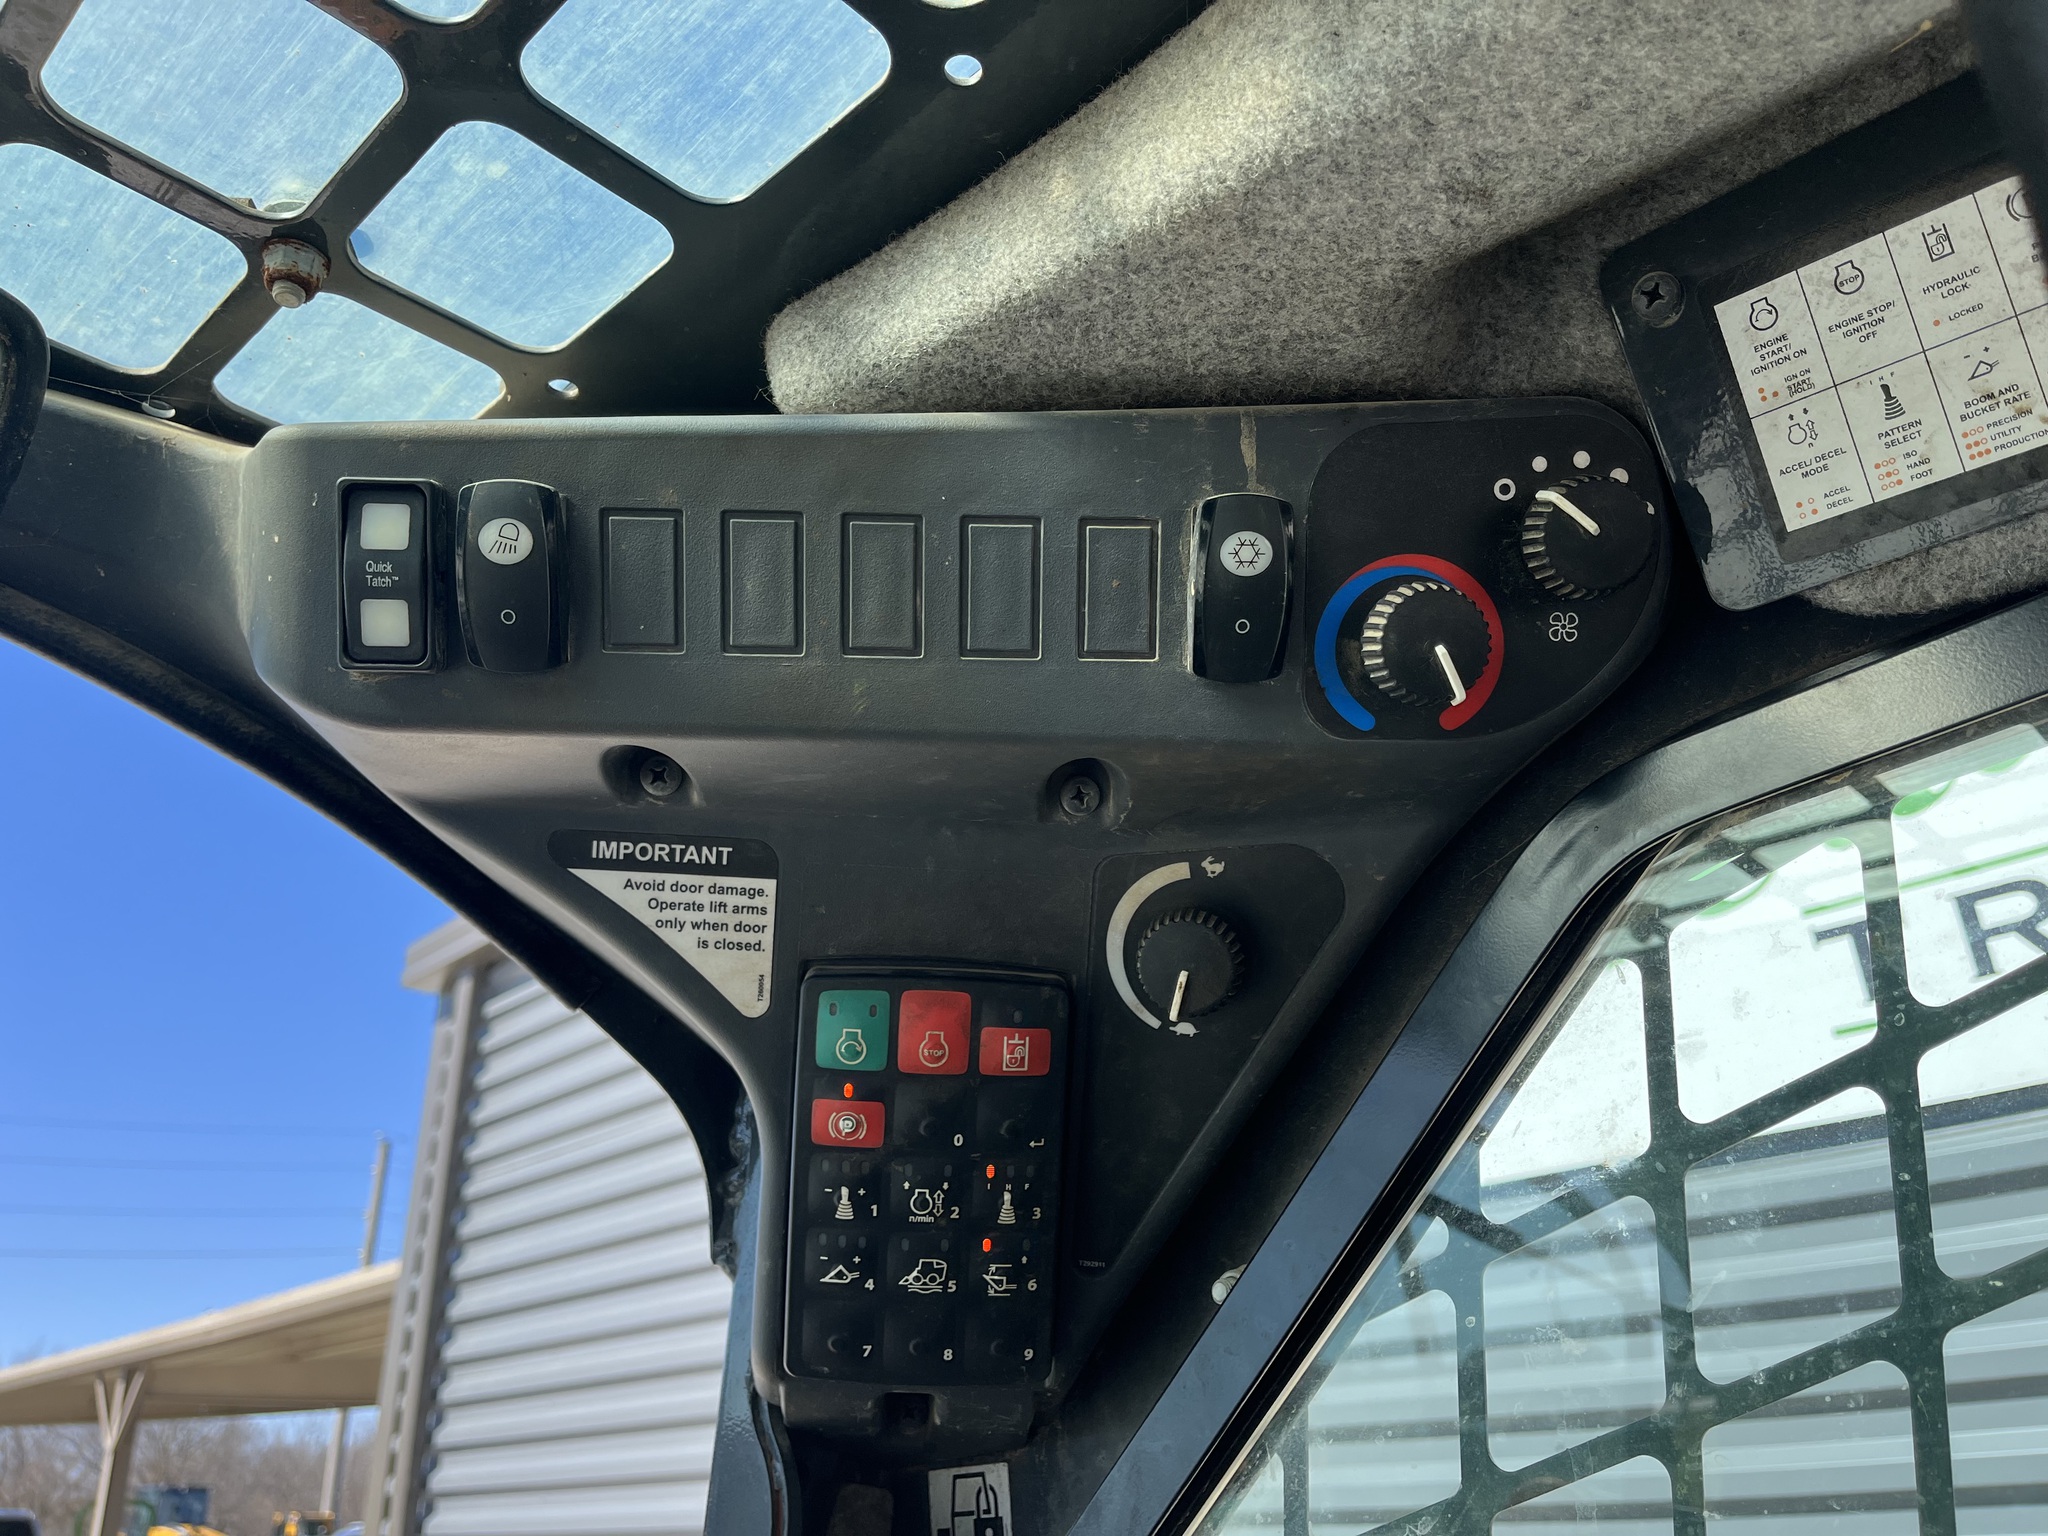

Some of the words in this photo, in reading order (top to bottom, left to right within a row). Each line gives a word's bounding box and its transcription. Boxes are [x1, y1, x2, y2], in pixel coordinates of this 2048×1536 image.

[1839, 274, 1860, 288] STOP
[1922, 265, 1981, 295] HYDRAULIC
[1941, 282, 1970, 299] LOCK
[1828, 313, 1865, 333] ENGINE
[1866, 300, 1896, 318] STOP/
[1948, 302, 1984, 321] LOCKED
[1842, 316, 1885, 339] IGNITION
[1753, 333, 1789, 353] ENGINE
[1858, 330, 1878, 343] OFF
[1759, 343, 1792, 362] START/
[1750, 354, 1791, 376] IGNITION
[1793, 347, 1807, 359] ON
[1783, 373, 1798, 383] IGN
[1799, 367, 1811, 377] ON
[1786, 376, 1811, 391] START
[1788, 382, 1816, 398] (HOLD)
[1963, 392, 1996, 409] BOOM
[1998, 383, 2020, 397] AND
[1959, 401, 2001, 423] BUCKET
[2004, 391, 2032, 407] RATE
[1986, 408, 2033, 430] PRECISION
[1877, 418, 1923, 440] PATTERN
[1990, 425, 2022, 441] UTILITY
[1884, 430, 1922, 449] SELECT
[1779, 458, 1813, 477] ACCEL/
[1814, 447, 1847, 464] DECEL
[1902, 449, 1918, 460] ISO
[1801, 463, 1830, 479] MODE
[1906, 457, 1931, 470] HAND
[1910, 468, 1933, 481] FOOT
[1823, 485, 1851, 499] ACCEL
[1826, 496, 1854, 510] DECEL
[365, 560, 393, 573] Quick
[592, 840, 733, 865] IMPORTANT
[623, 878, 665, 892] Avoid
[670, 881, 704, 894] door
[708, 883, 769, 899] damage.
[648, 898, 705, 912] Operate
[710, 901, 728, 914] lift
[732, 904, 768, 916] arms
[655, 917, 686, 932] only
[691, 919, 729, 932] when
[734, 921, 768, 934] door
[697, 937, 709, 949] is
[714, 938, 766, 952] closed.
[923, 1048, 945, 1057] STOP
[953, 1133, 964, 1147] 0
[1005, 1183, 1011, 1191] H
[870, 1204, 878, 1217] 1
[950, 1206, 960, 1219] 2
[1032, 1207, 1042, 1219] 3
[909, 1214, 935, 1223] n/min
[864, 1278, 875, 1291] 4
[947, 1280, 957, 1292] 5
[1027, 1279, 1038, 1291] 6
[862, 1345, 872, 1357] 7
[943, 1349, 953, 1361] 8
[1023, 1348, 1034, 1361] 9
